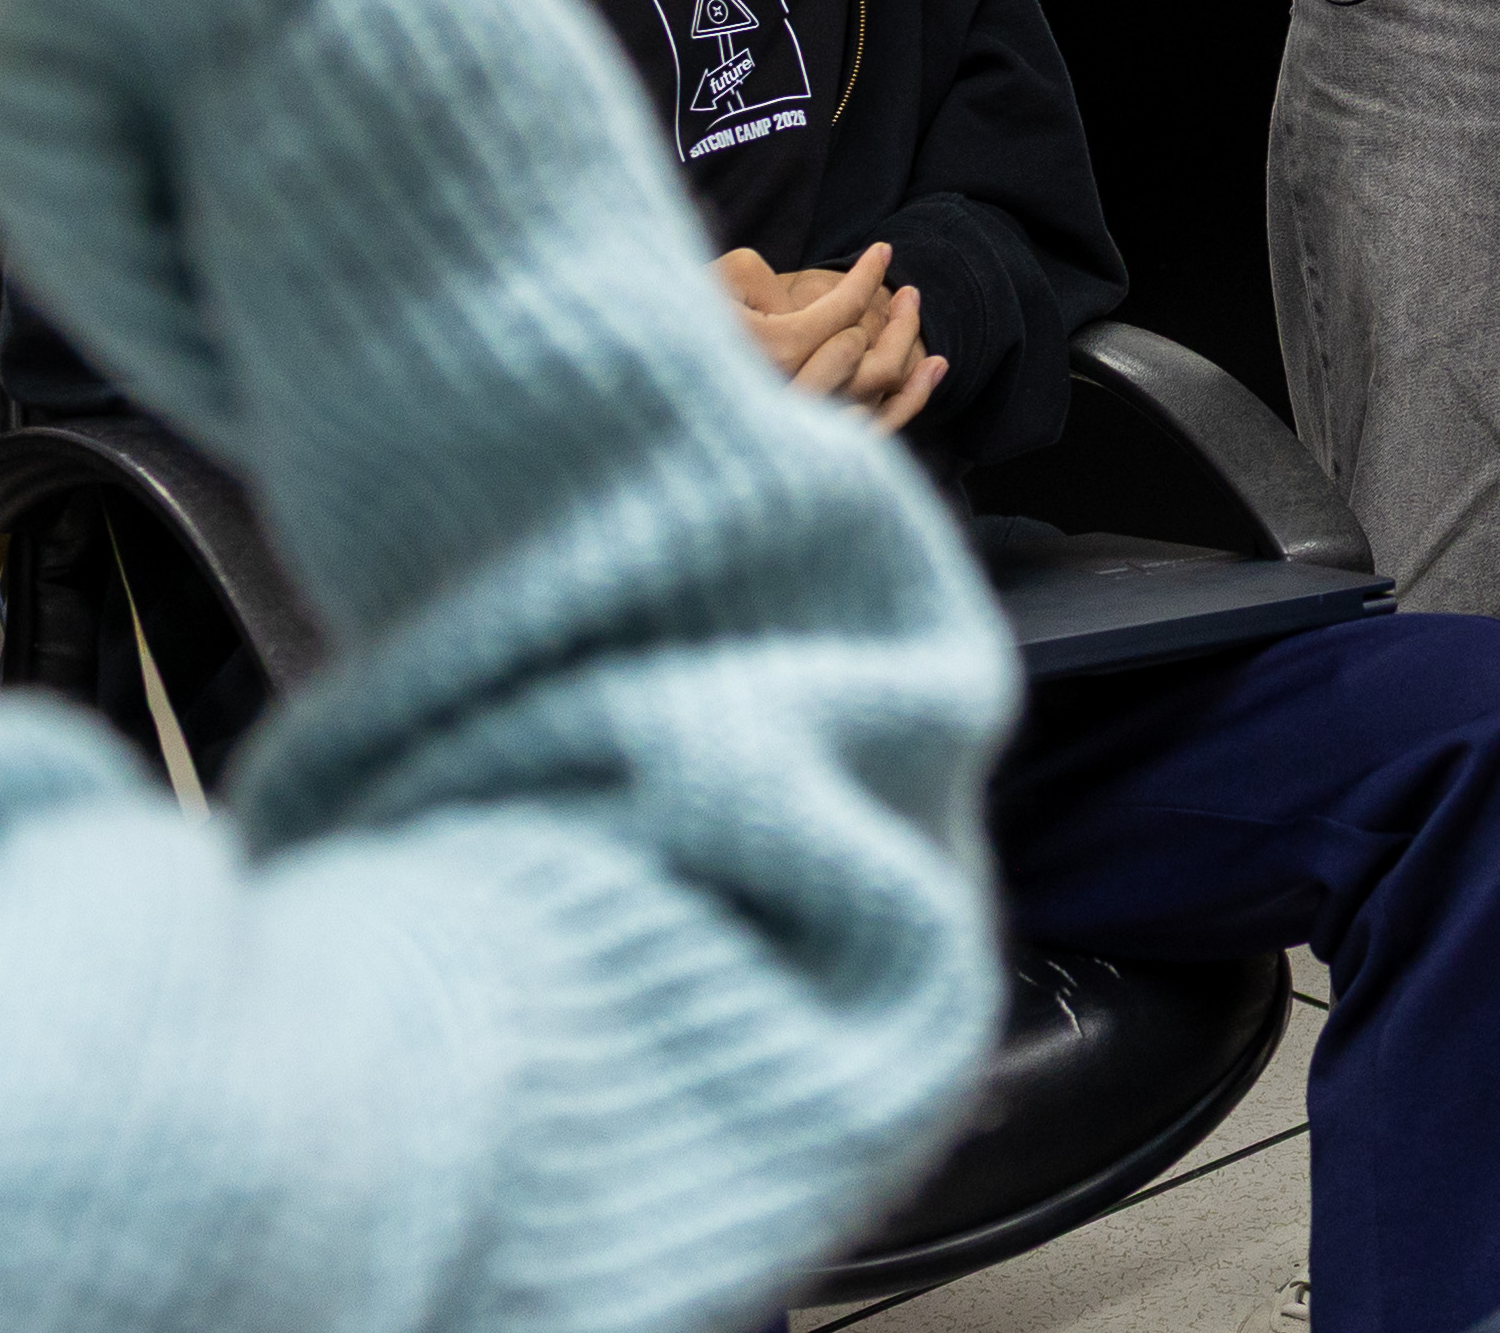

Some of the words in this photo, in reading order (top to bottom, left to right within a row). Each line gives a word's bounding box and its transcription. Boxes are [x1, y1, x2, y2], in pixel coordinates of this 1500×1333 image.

[709, 58, 752, 95] future
[689, 128, 736, 159] SITCON
[735, 116, 772, 144] CAMP
